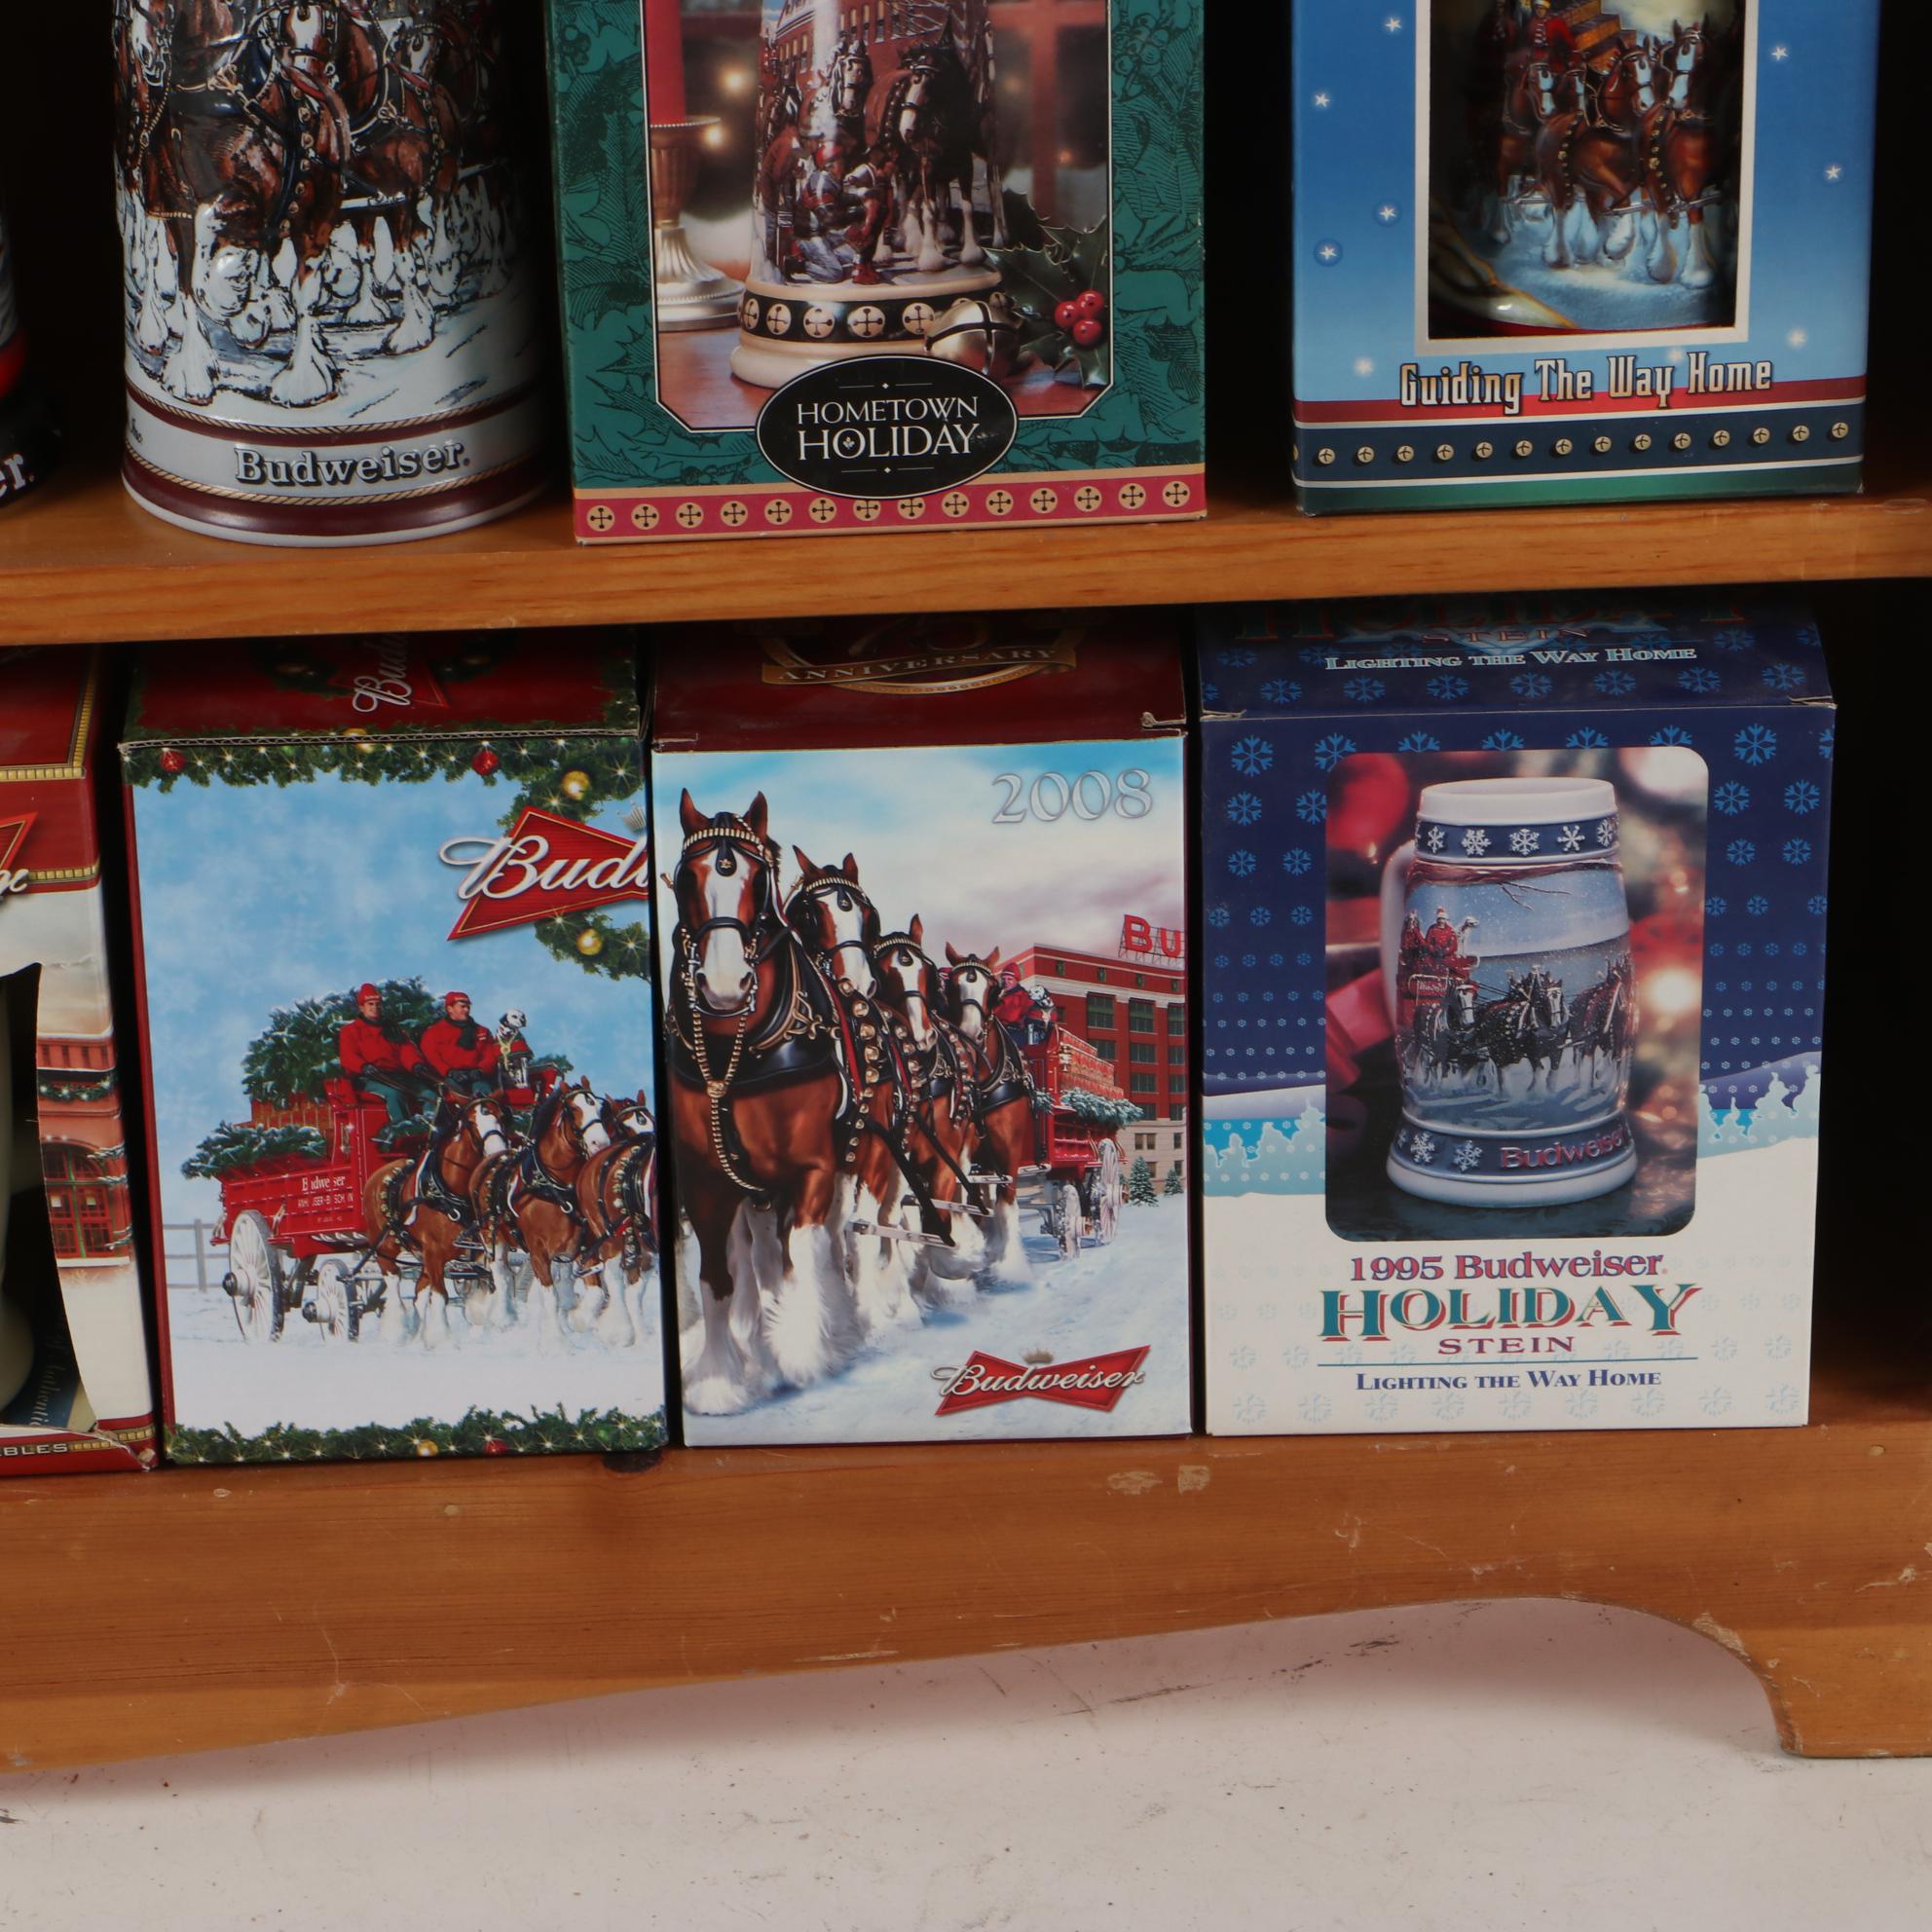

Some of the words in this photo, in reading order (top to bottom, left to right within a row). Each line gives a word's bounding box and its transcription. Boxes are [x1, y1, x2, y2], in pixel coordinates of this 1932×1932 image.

[1399, 361, 1524, 415] Guiding
[1534, 357, 1592, 401] The
[1607, 354, 1675, 409] Way
[1686, 351, 1772, 394] Home
[797, 395, 980, 425] HOMETOWN
[798, 423, 981, 461] HOLIDAY
[778, 648, 1058, 681] ANNIVERSARY
[991, 767, 1154, 825] 2008
[1351, 1255, 1444, 1282] 1995
[1318, 1282, 1703, 1342] HOLIDAY
[1437, 1336, 1576, 1355] STEIN
[930, 1362, 1146, 1397] Budweiser
